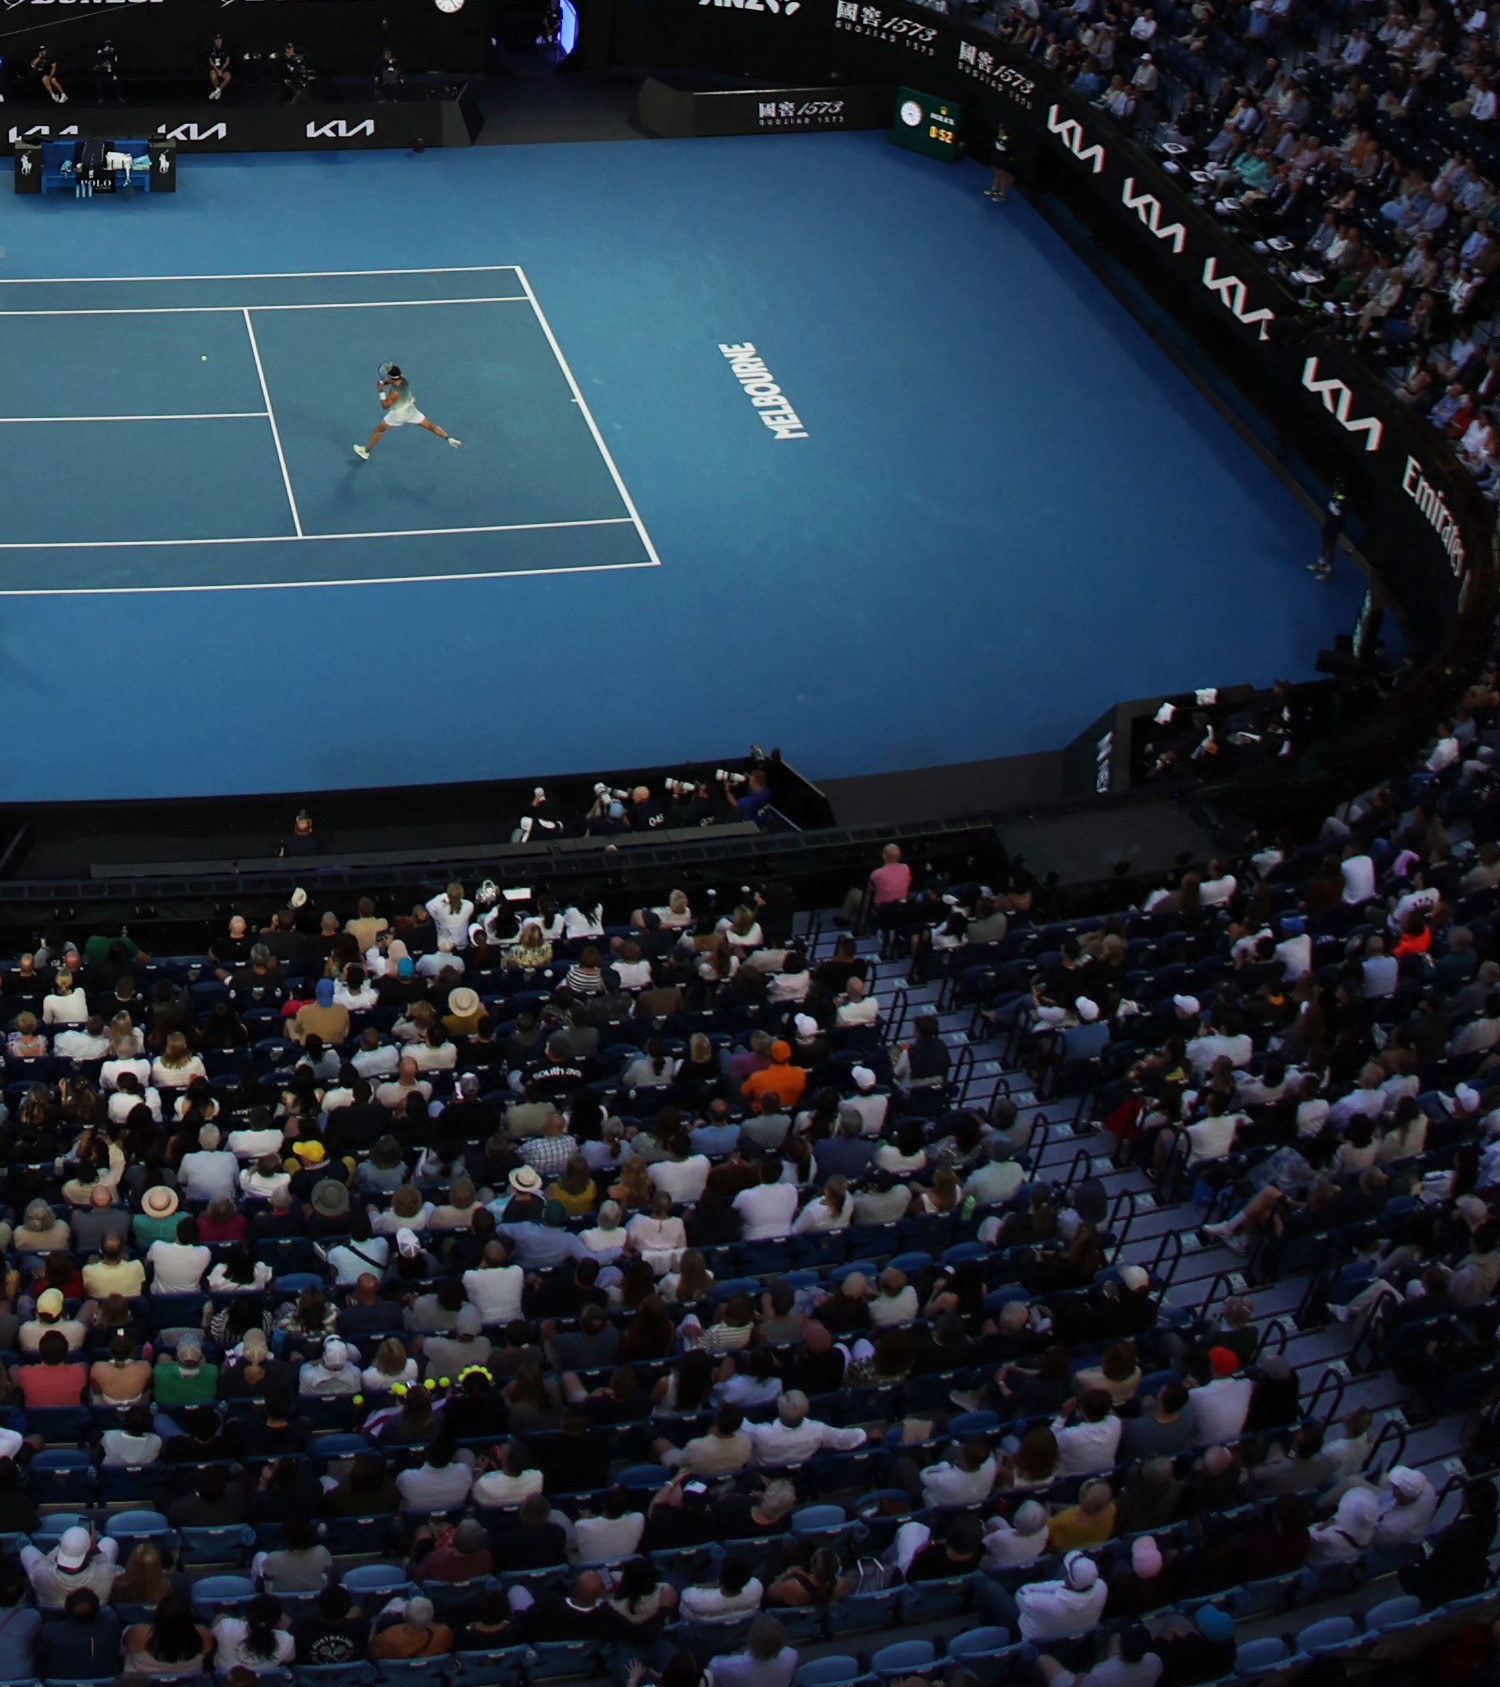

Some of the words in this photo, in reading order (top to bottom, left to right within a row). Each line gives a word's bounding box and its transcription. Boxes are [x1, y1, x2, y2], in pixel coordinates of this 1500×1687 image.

[157, 122, 227, 140] KIA
[306, 119, 375, 138] KIA
[1047, 104, 1106, 174] KIA
[1122, 177, 1187, 254] KIA
[1203, 257, 1275, 341] KIA
[718, 342, 810, 440] MELBOURNE
[1302, 356, 1383, 452] KIA
